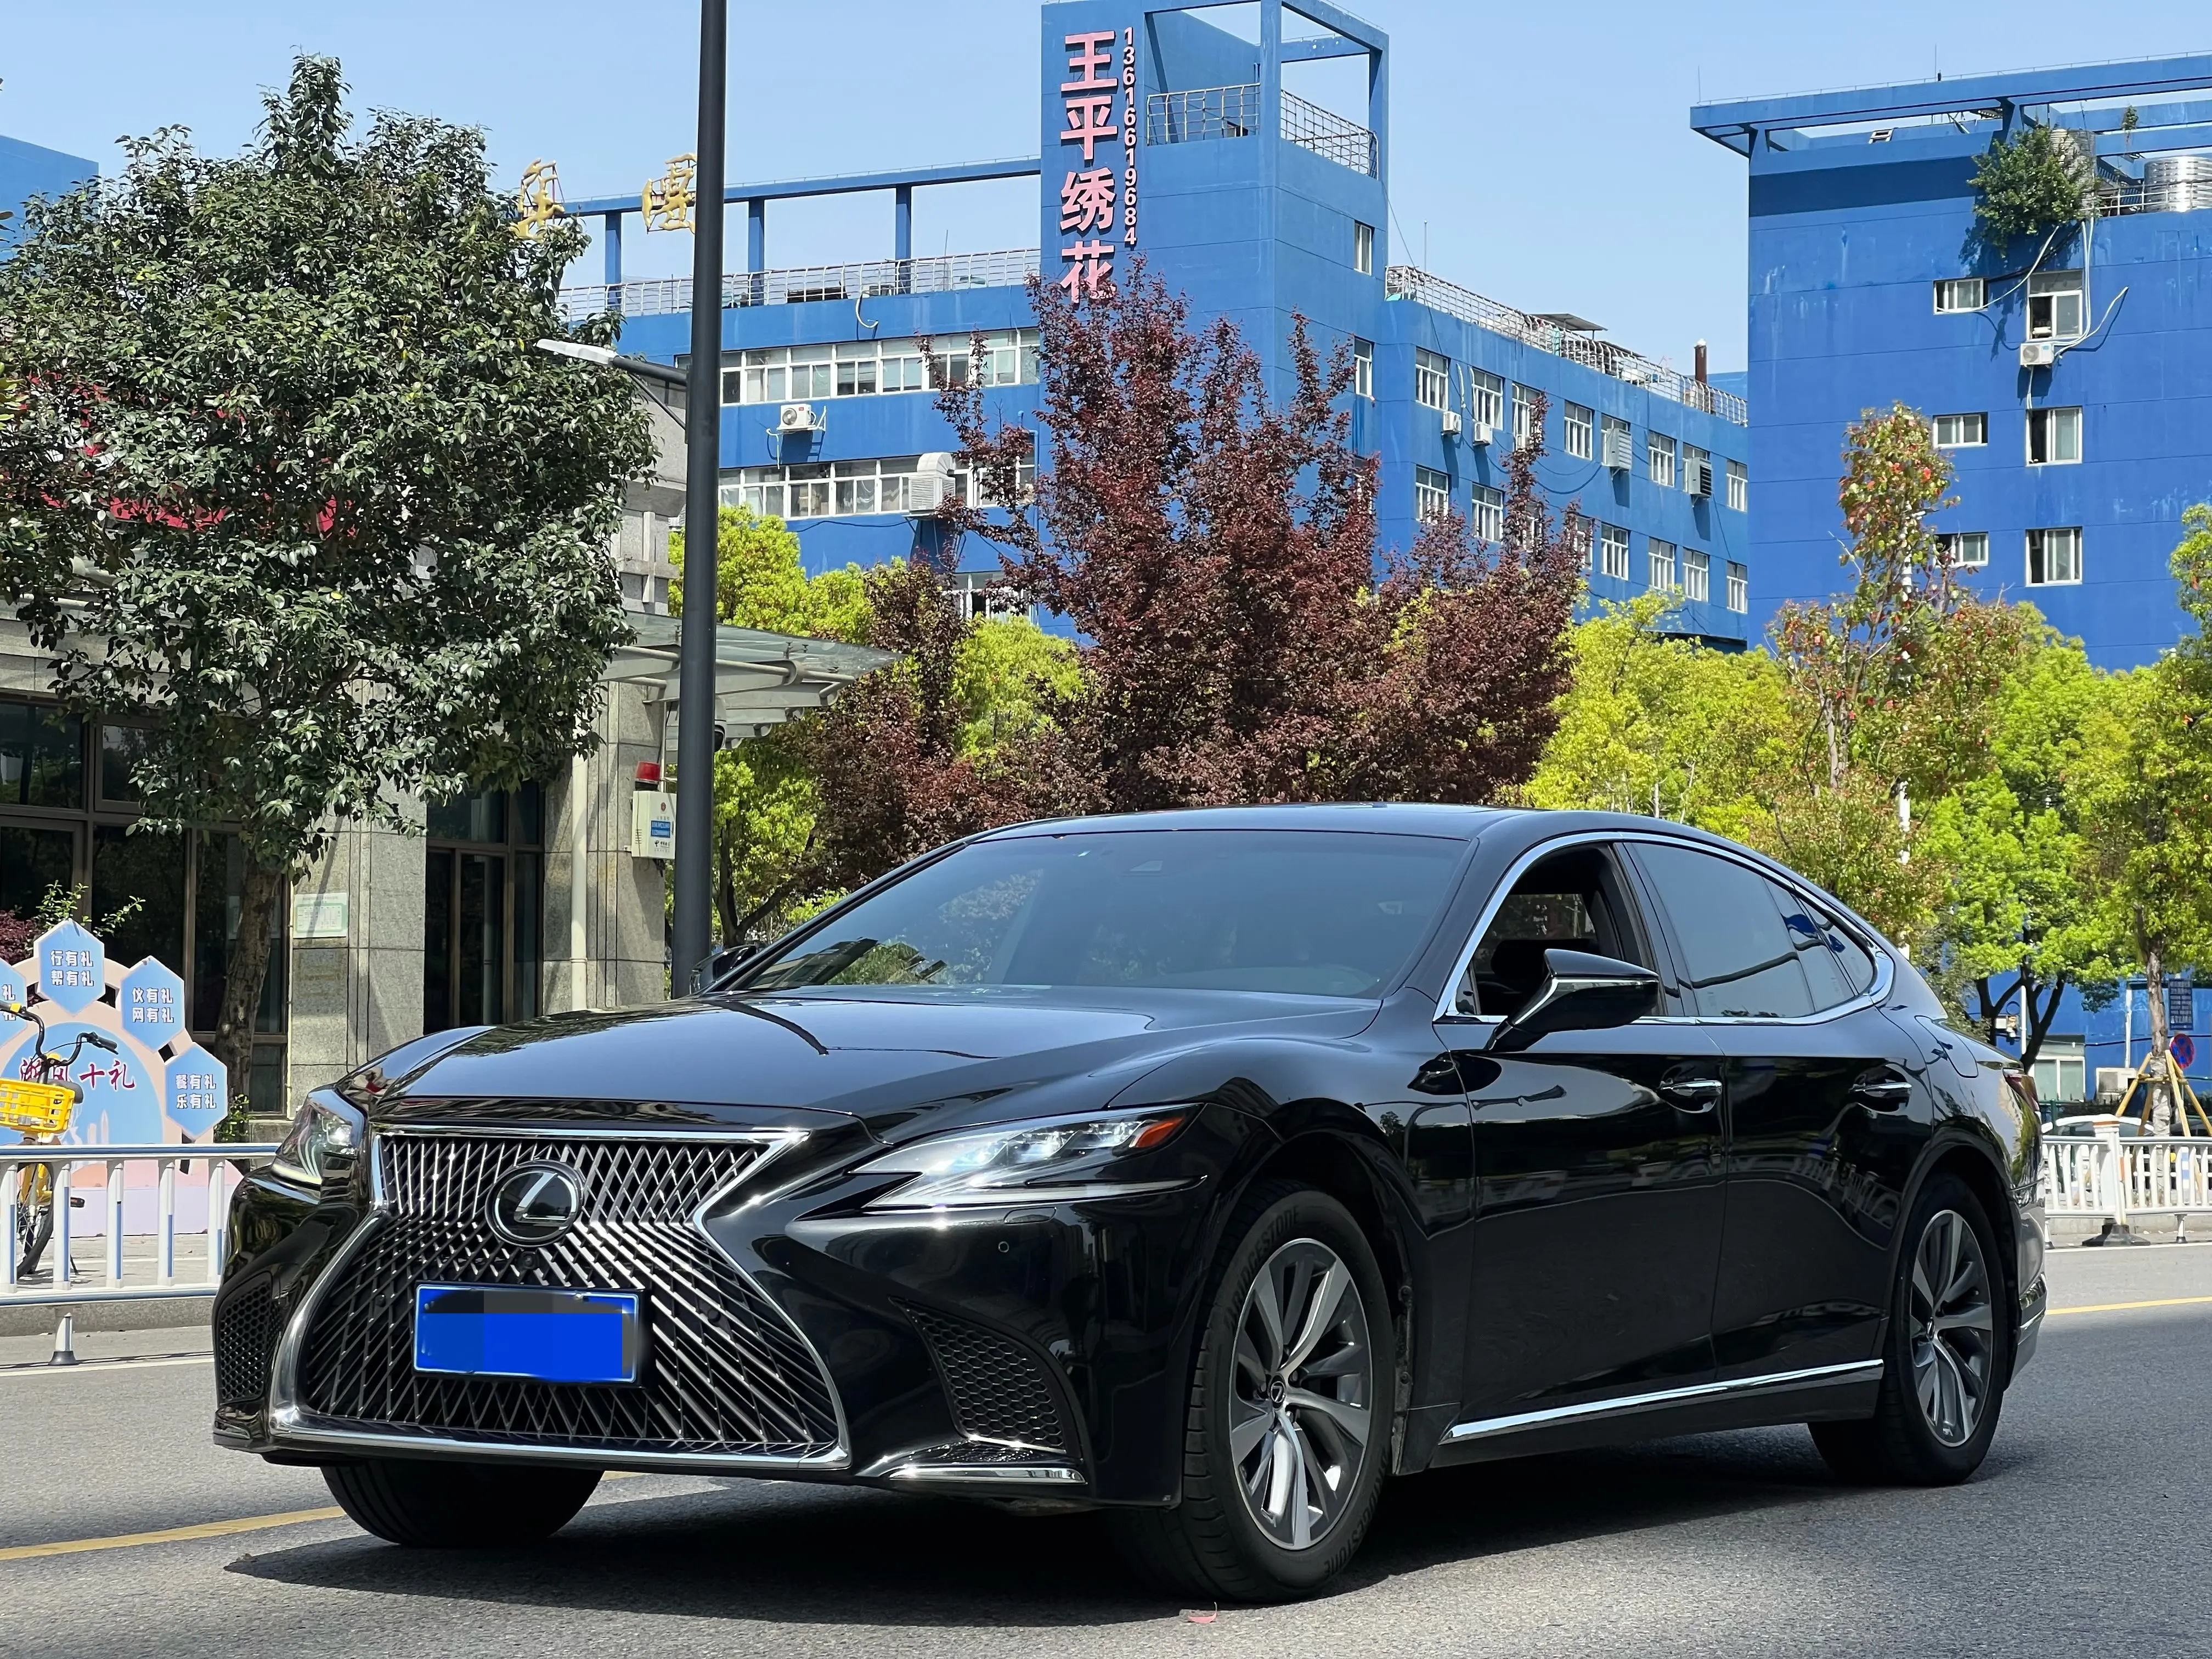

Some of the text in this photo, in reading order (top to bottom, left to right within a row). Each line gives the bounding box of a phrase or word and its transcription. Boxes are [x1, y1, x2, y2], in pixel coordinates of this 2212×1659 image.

[1122, 26, 1137, 245] 13616619684
[1060, 30, 1118, 304] 王平绣花
[50, 950, 94, 967] 行有礼
[50, 970, 94, 986] 帮有礼
[132, 988, 173, 1004] 仪有礼
[132, 1007, 174, 1023] 网有礼
[176, 1074, 217, 1090] 餐有礼
[176, 1093, 217, 1109] 乐有礼
[1223, 1205, 1301, 1331] BRIDGESTONE
